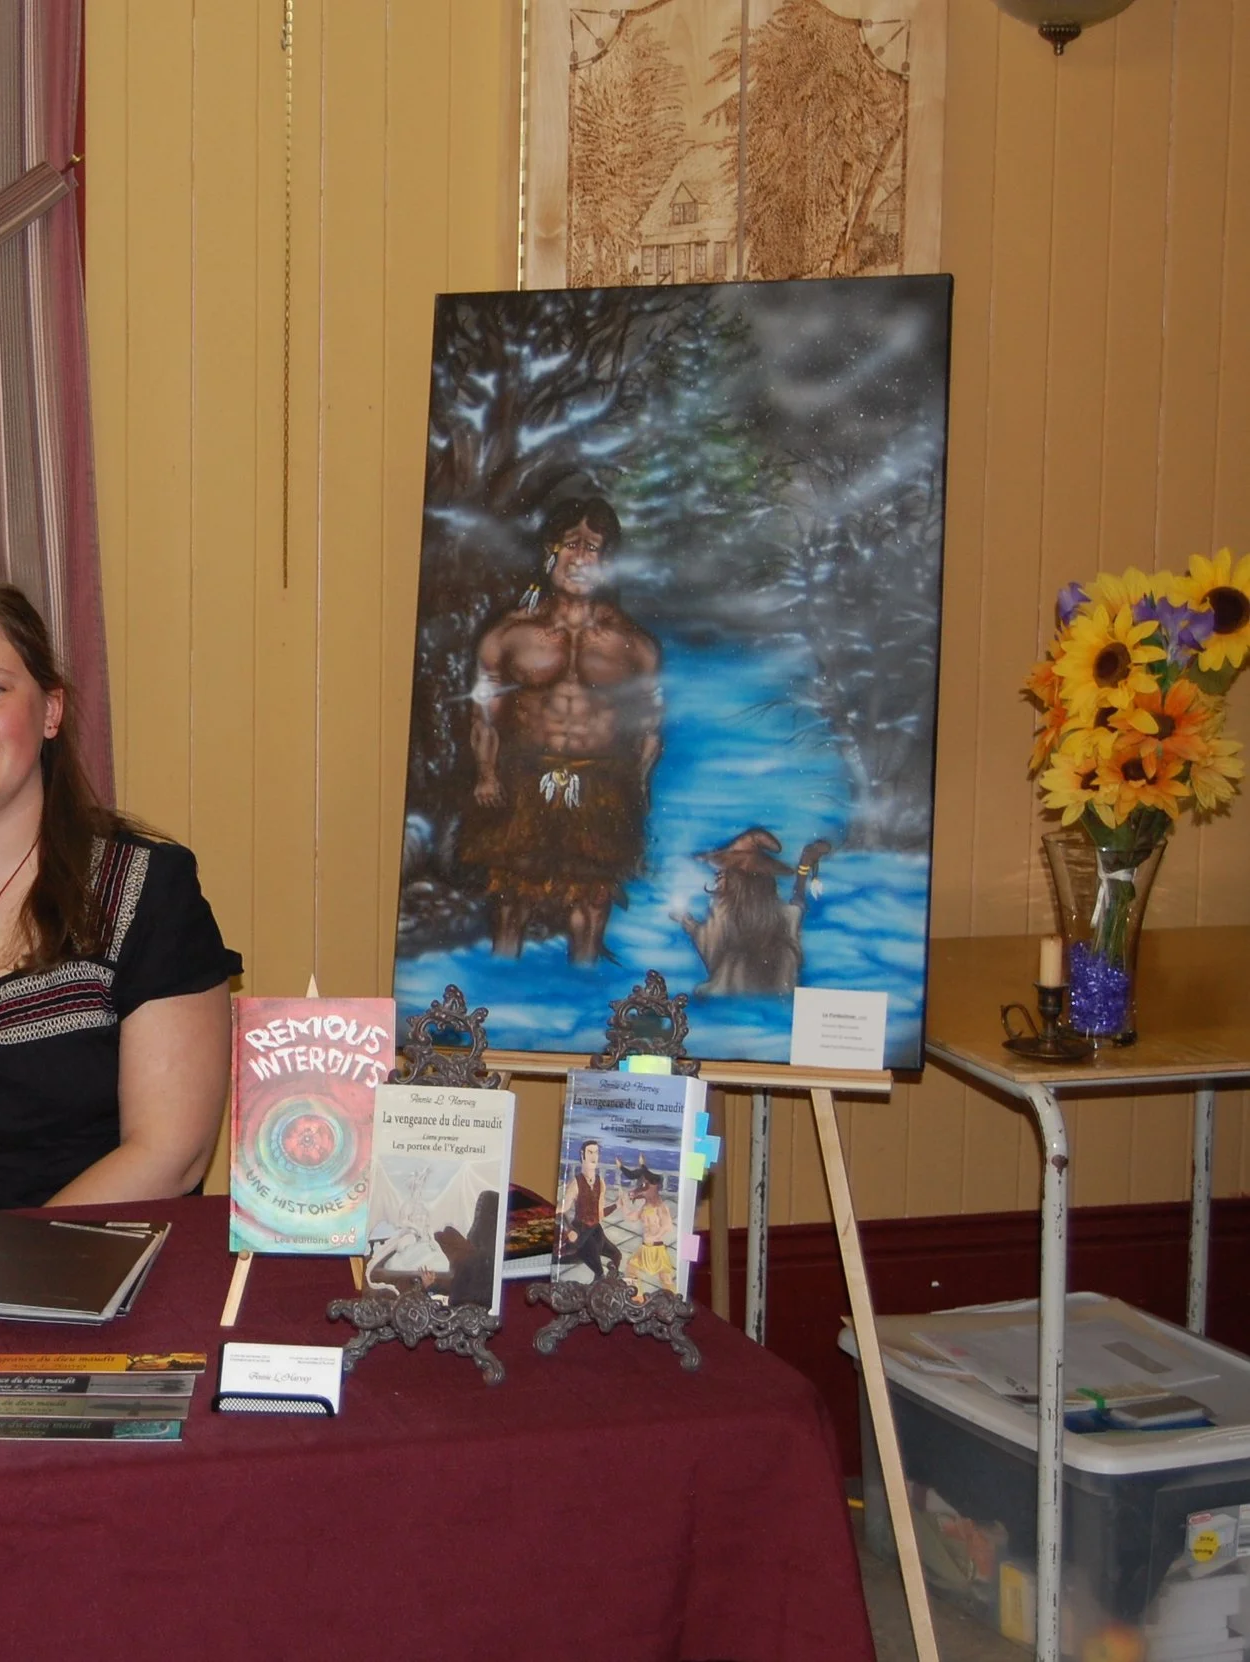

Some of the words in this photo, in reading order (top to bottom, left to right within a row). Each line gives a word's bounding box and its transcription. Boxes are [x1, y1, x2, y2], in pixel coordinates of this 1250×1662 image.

[245, 1015, 389, 1054] REMOUS
[249, 1046, 388, 1088] INTERDITS
[448, 1095, 477, 1108] Harvey
[573, 1095, 583, 1106] La
[584, 1097, 626, 1110] vengeance
[626, 1097, 636, 1110] du
[637, 1099, 654, 1112] dieu
[656, 1101, 685, 1114] maudit
[382, 1111, 392, 1124] La
[394, 1115, 437, 1128] vengeance
[439, 1114, 450, 1126] du
[452, 1114, 470, 1128] dieu
[473, 1116, 502, 1129] maudit
[392, 1141, 404, 1150] Les
[406, 1142, 431, 1153] portes
[432, 1141, 442, 1151] de
[444, 1143, 486, 1155] l'Yggdrasil
[246, 1169, 270, 1198] UNE
[272, 1194, 344, 1215] HISTOIRE
[275, 1235, 290, 1244] Les
[292, 1234, 329, 1244] éditions
[45, 1376, 76, 1384] maudit
[8, 1420, 23, 1428] du
[26, 1420, 49, 1429] dieu
[52, 1420, 93, 1429] maudit
